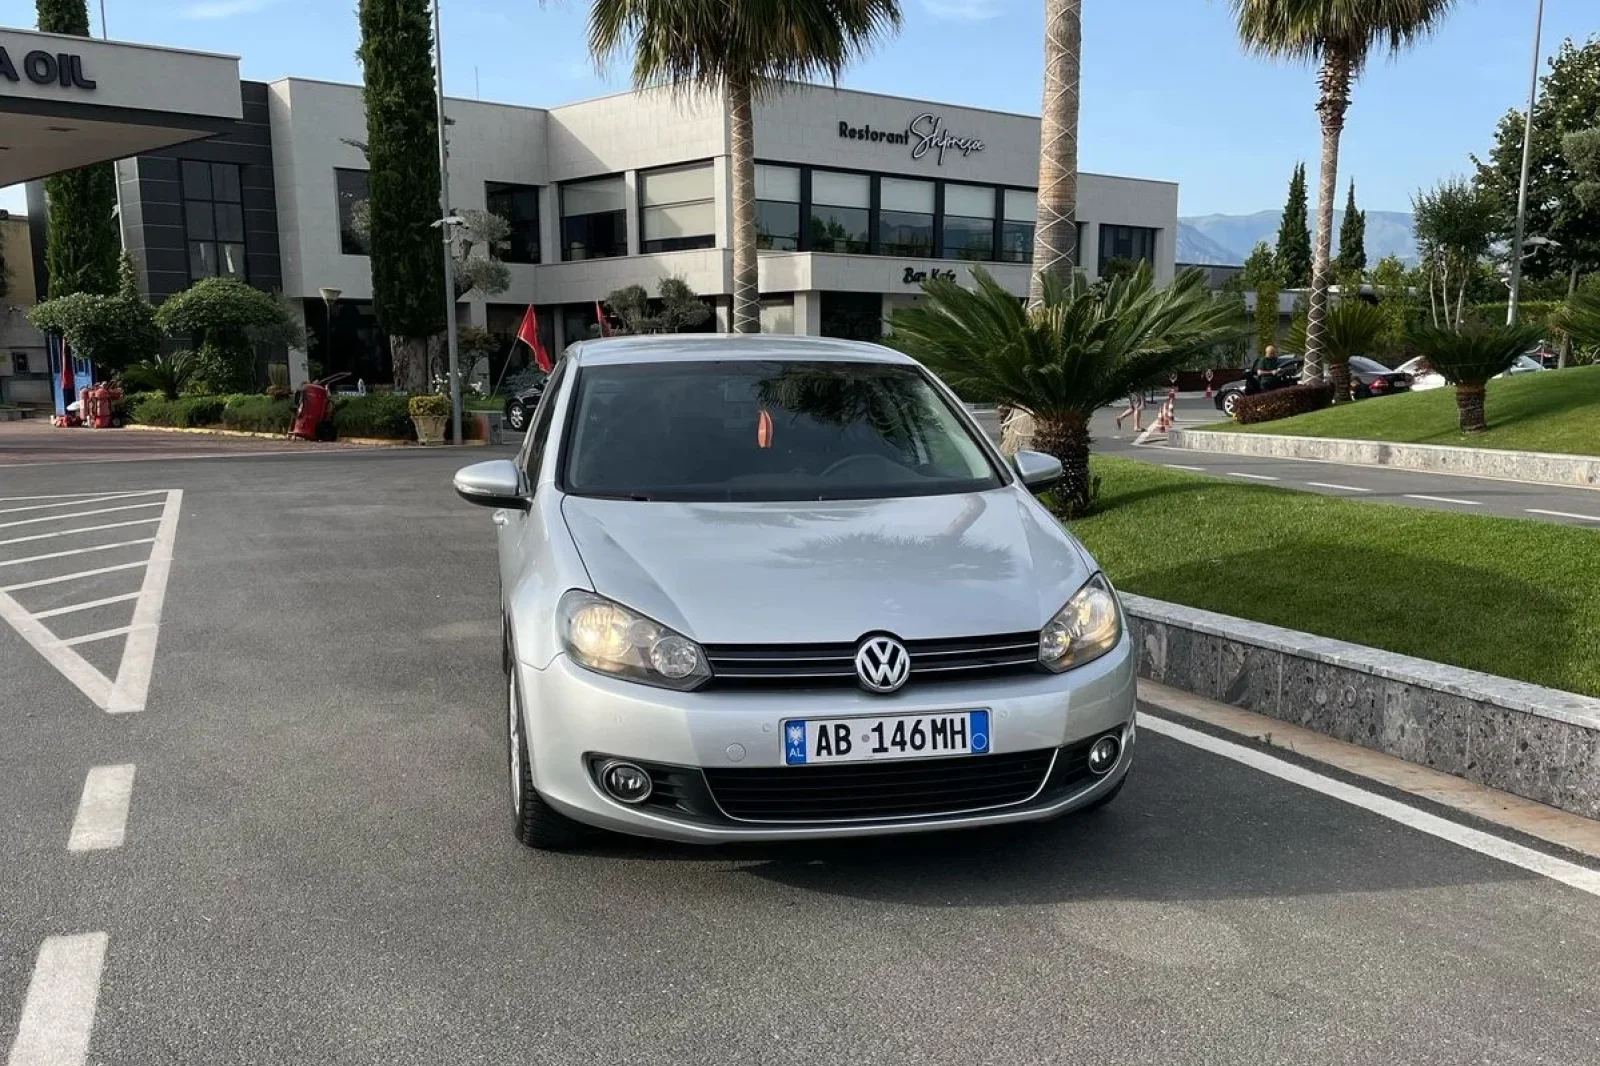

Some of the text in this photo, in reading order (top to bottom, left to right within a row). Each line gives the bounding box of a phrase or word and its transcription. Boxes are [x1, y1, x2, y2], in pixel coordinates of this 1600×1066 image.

[23, 50, 96, 89] OIL
[838, 120, 909, 145] Restorant
[789, 747, 805, 758] AL
[815, 724, 852, 757] AB
